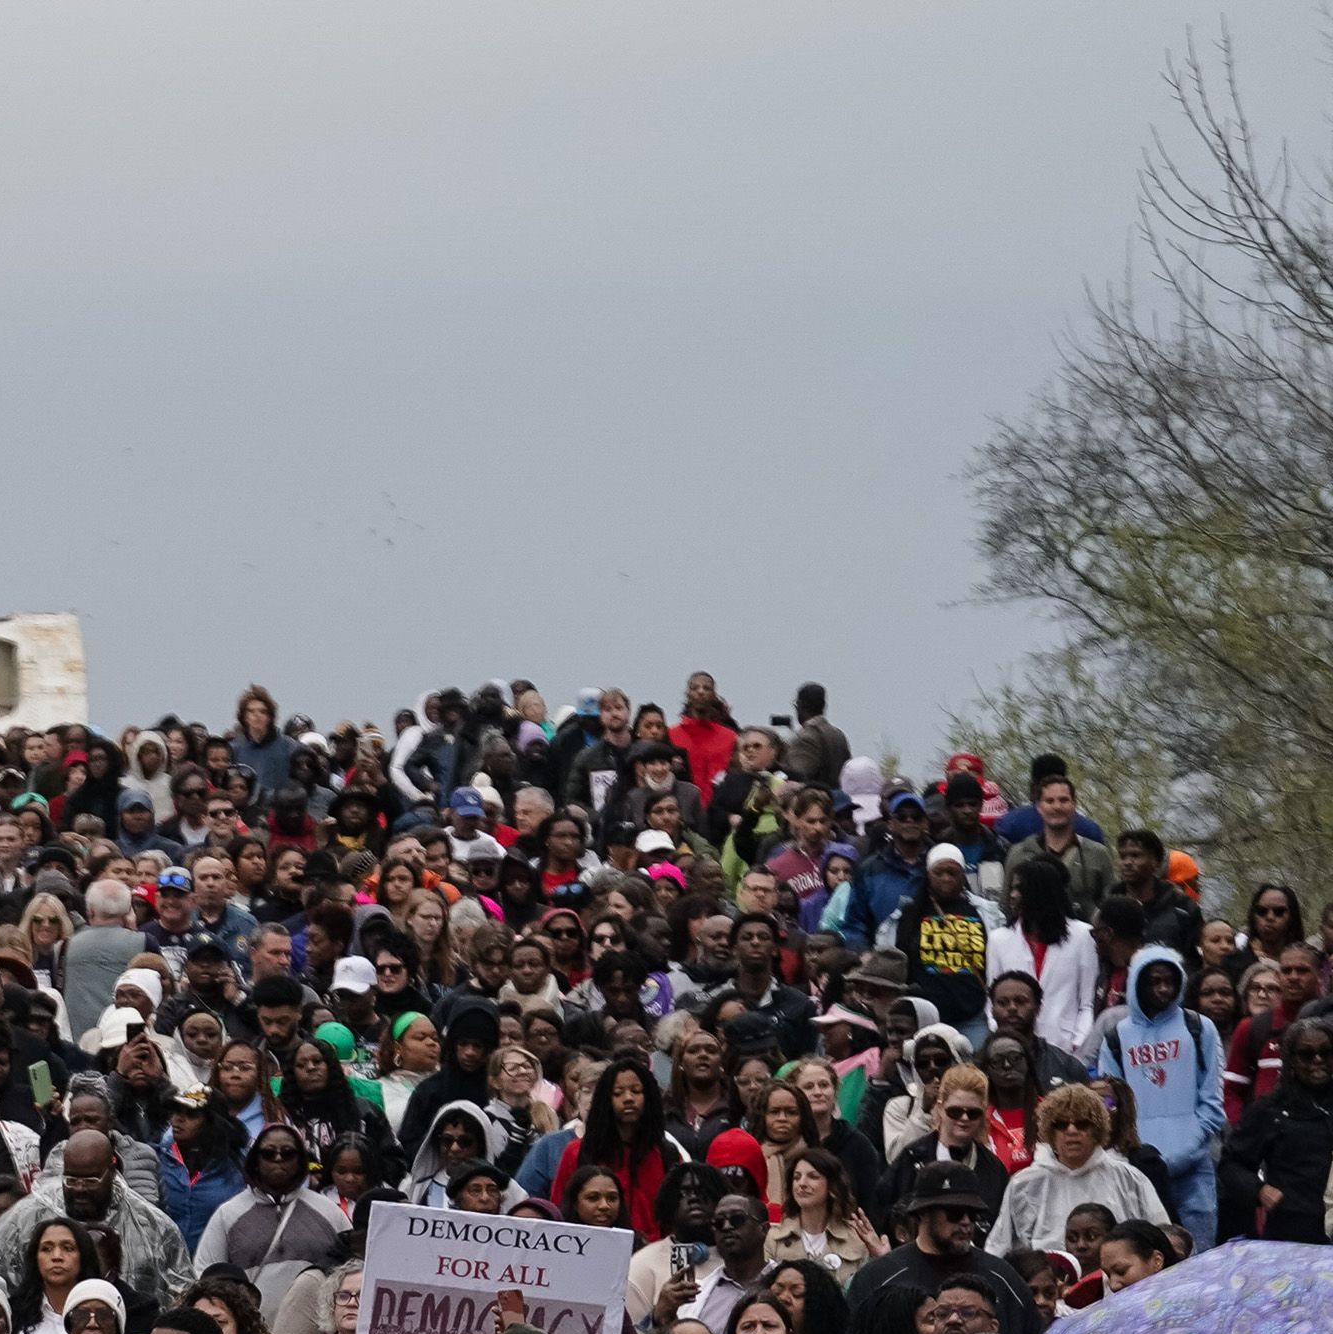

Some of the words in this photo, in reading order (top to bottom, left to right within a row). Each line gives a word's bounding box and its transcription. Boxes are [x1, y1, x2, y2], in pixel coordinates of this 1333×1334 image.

[920, 918, 983, 936] BLACK
[920, 933, 985, 953] LIVES
[920, 950, 985, 970] MATTER
[1127, 1039, 1181, 1067] 1867
[407, 1216, 591, 1256] DEMOCRACY
[436, 1255, 491, 1281] FOR
[498, 1263, 551, 1287] ALL
